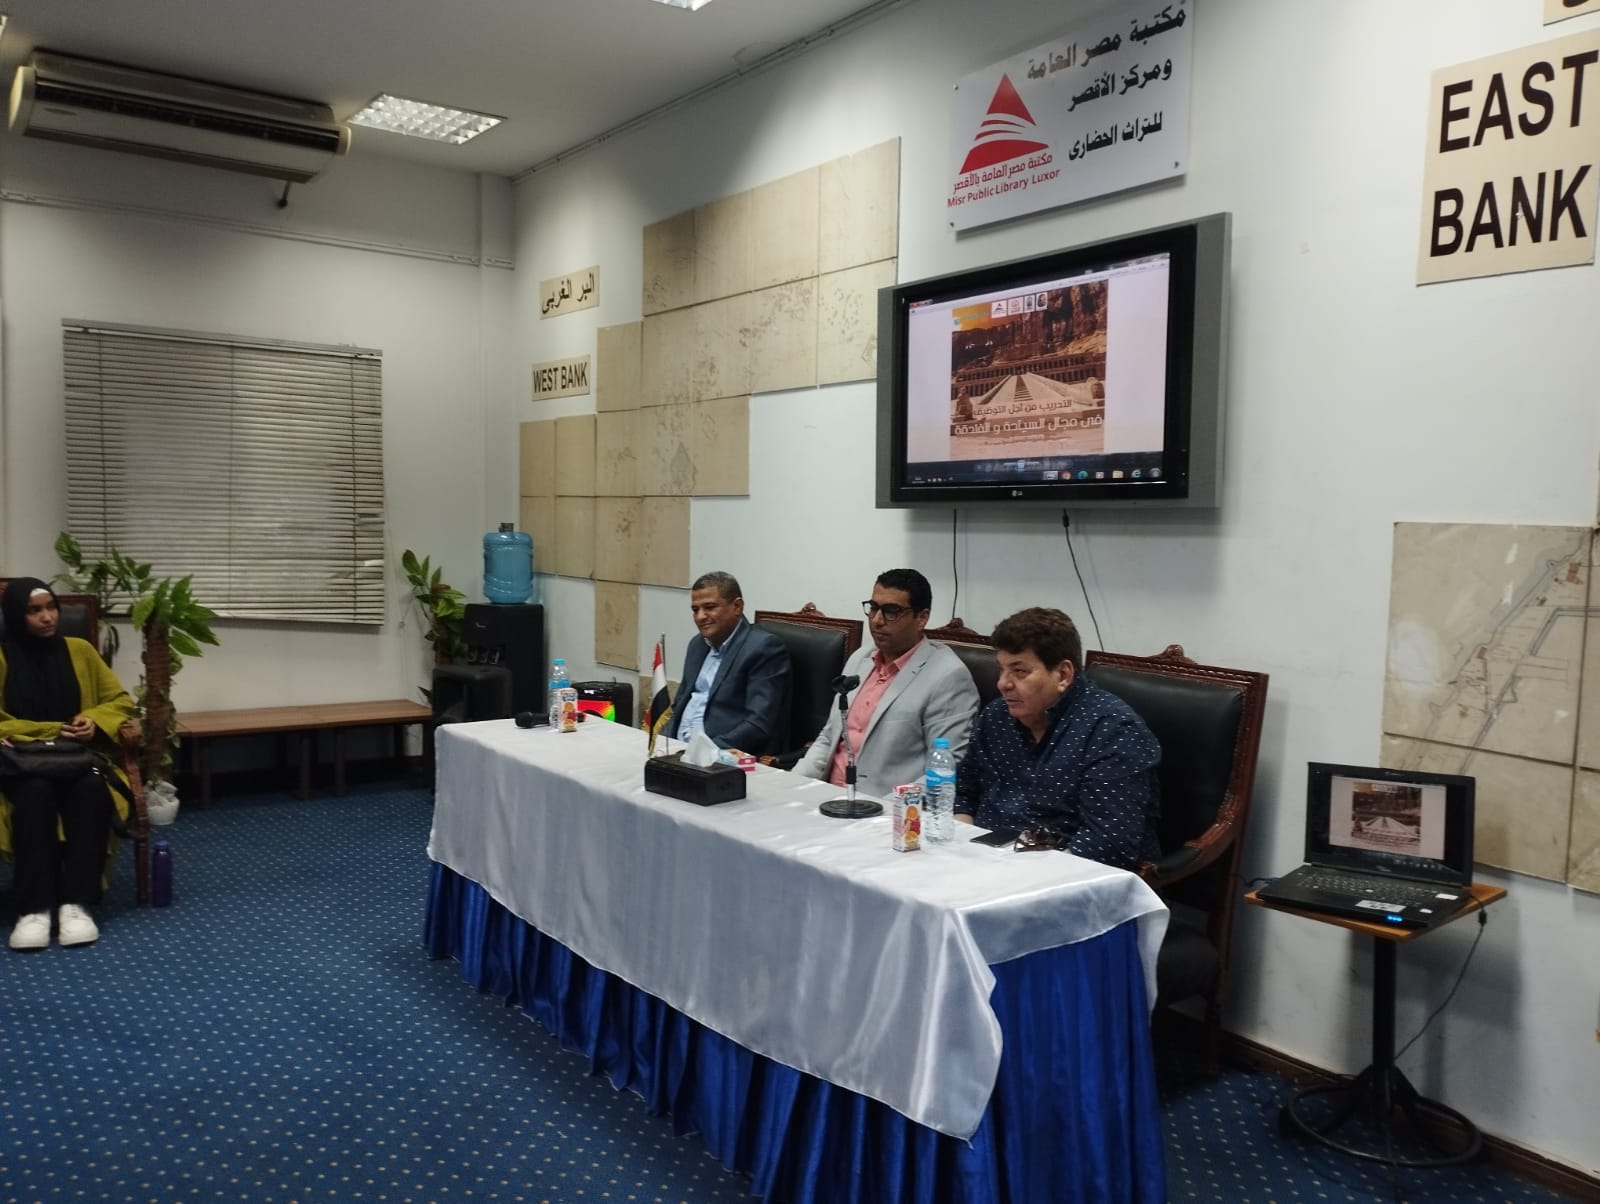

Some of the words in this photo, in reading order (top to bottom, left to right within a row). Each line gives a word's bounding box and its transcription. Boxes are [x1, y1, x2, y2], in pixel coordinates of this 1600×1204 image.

[1129, 3, 1187, 45] مكتبة
[1027, 43, 1077, 80] العامة
[1081, 32, 1122, 67] مصر
[1119, 58, 1173, 95] ومركز
[1439, 49, 1600, 154] EAST
[1121, 111, 1163, 142] للتراث
[981, 164, 1008, 183] العامة
[1008, 163, 1025, 178] مصر
[1028, 153, 1053, 169] مكتبة
[947, 196, 966, 209] Misr
[967, 186, 994, 202] Public
[995, 177, 1029, 194] Library
[1031, 169, 1061, 185] Luxor
[1430, 164, 1592, 258] BANK
[576, 271, 595, 302] البر
[533, 366, 559, 393] WEST
[560, 361, 588, 390] BANK
[1024, 404, 1038, 413] من
[1039, 399, 1072, 413] التدريب
[993, 423, 1001, 435] و
[1003, 418, 1045, 434] السياحة
[1047, 416, 1078, 431] مجال
